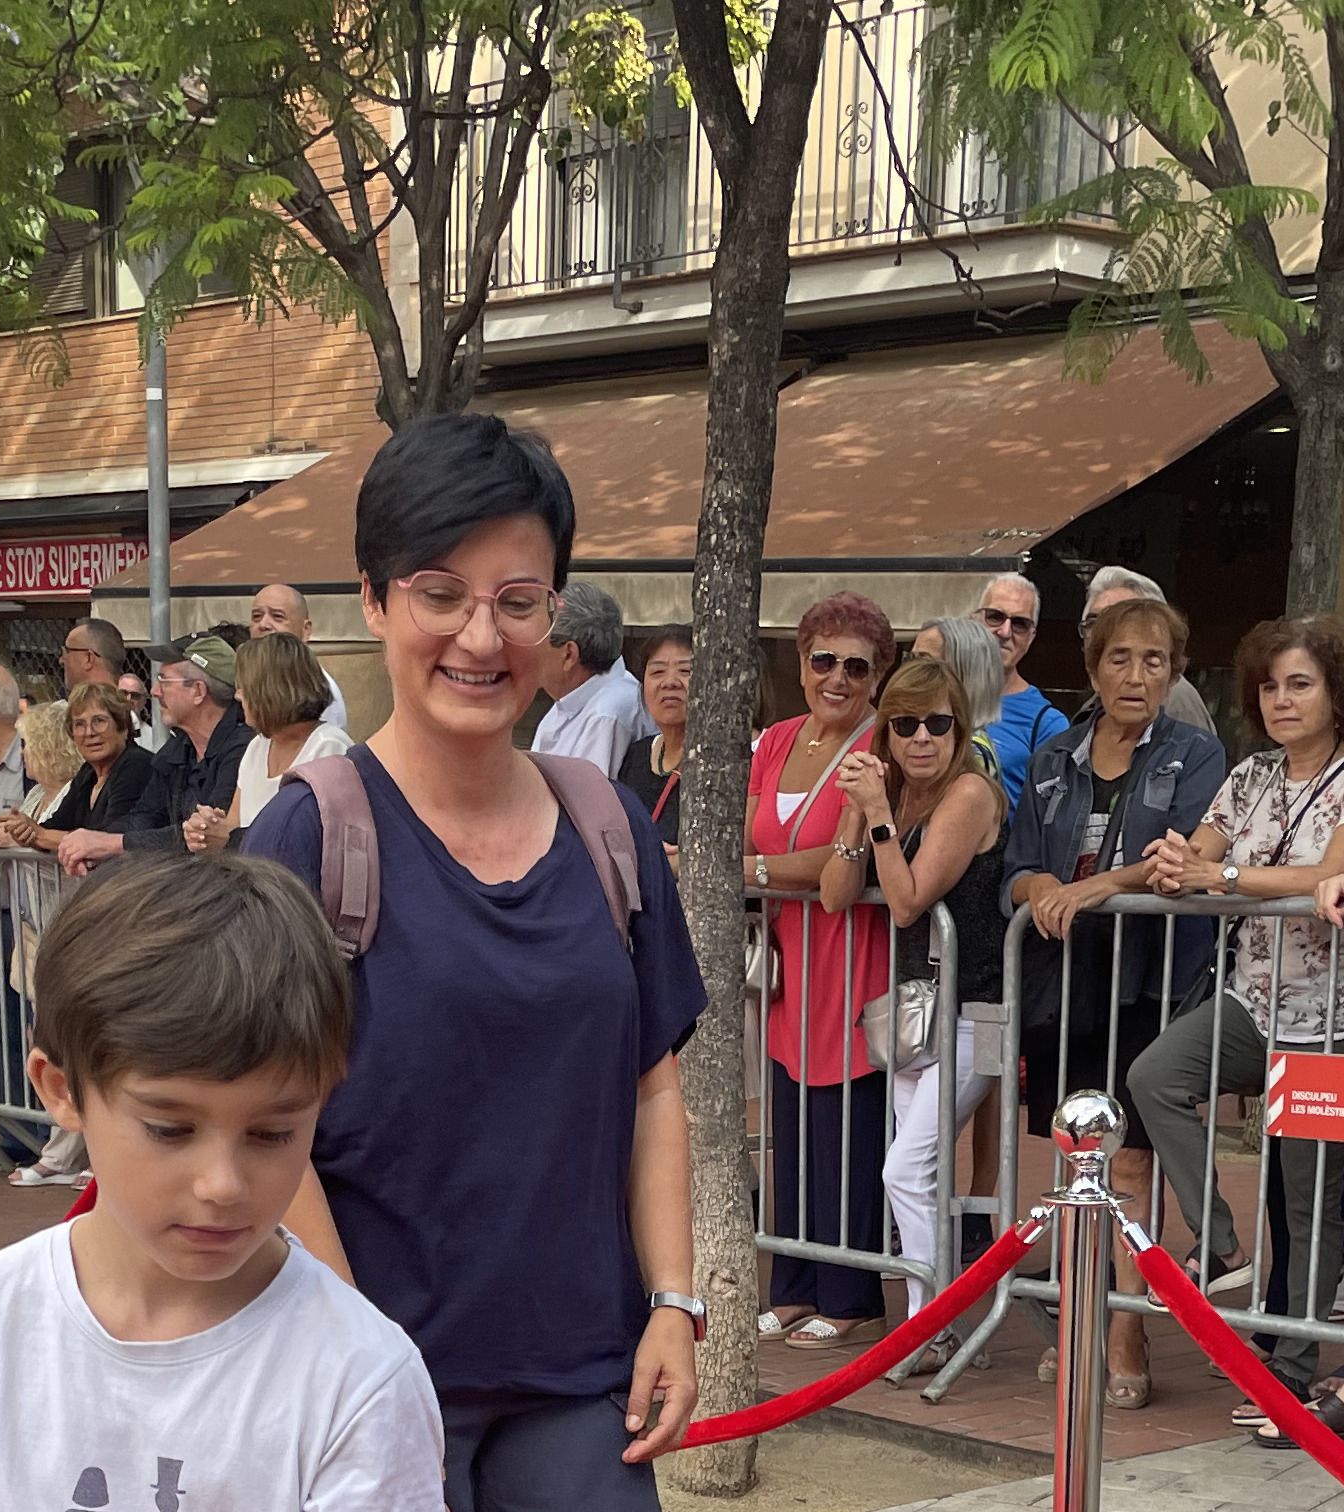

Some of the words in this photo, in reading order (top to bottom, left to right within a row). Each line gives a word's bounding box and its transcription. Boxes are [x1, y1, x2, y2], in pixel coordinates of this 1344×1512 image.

[6, 547, 45, 588] STOP
[48, 541, 149, 587] SUPERMERC
[1291, 1090, 1338, 1103] DISCULPEU
[1290, 1104, 1306, 1114] LES
